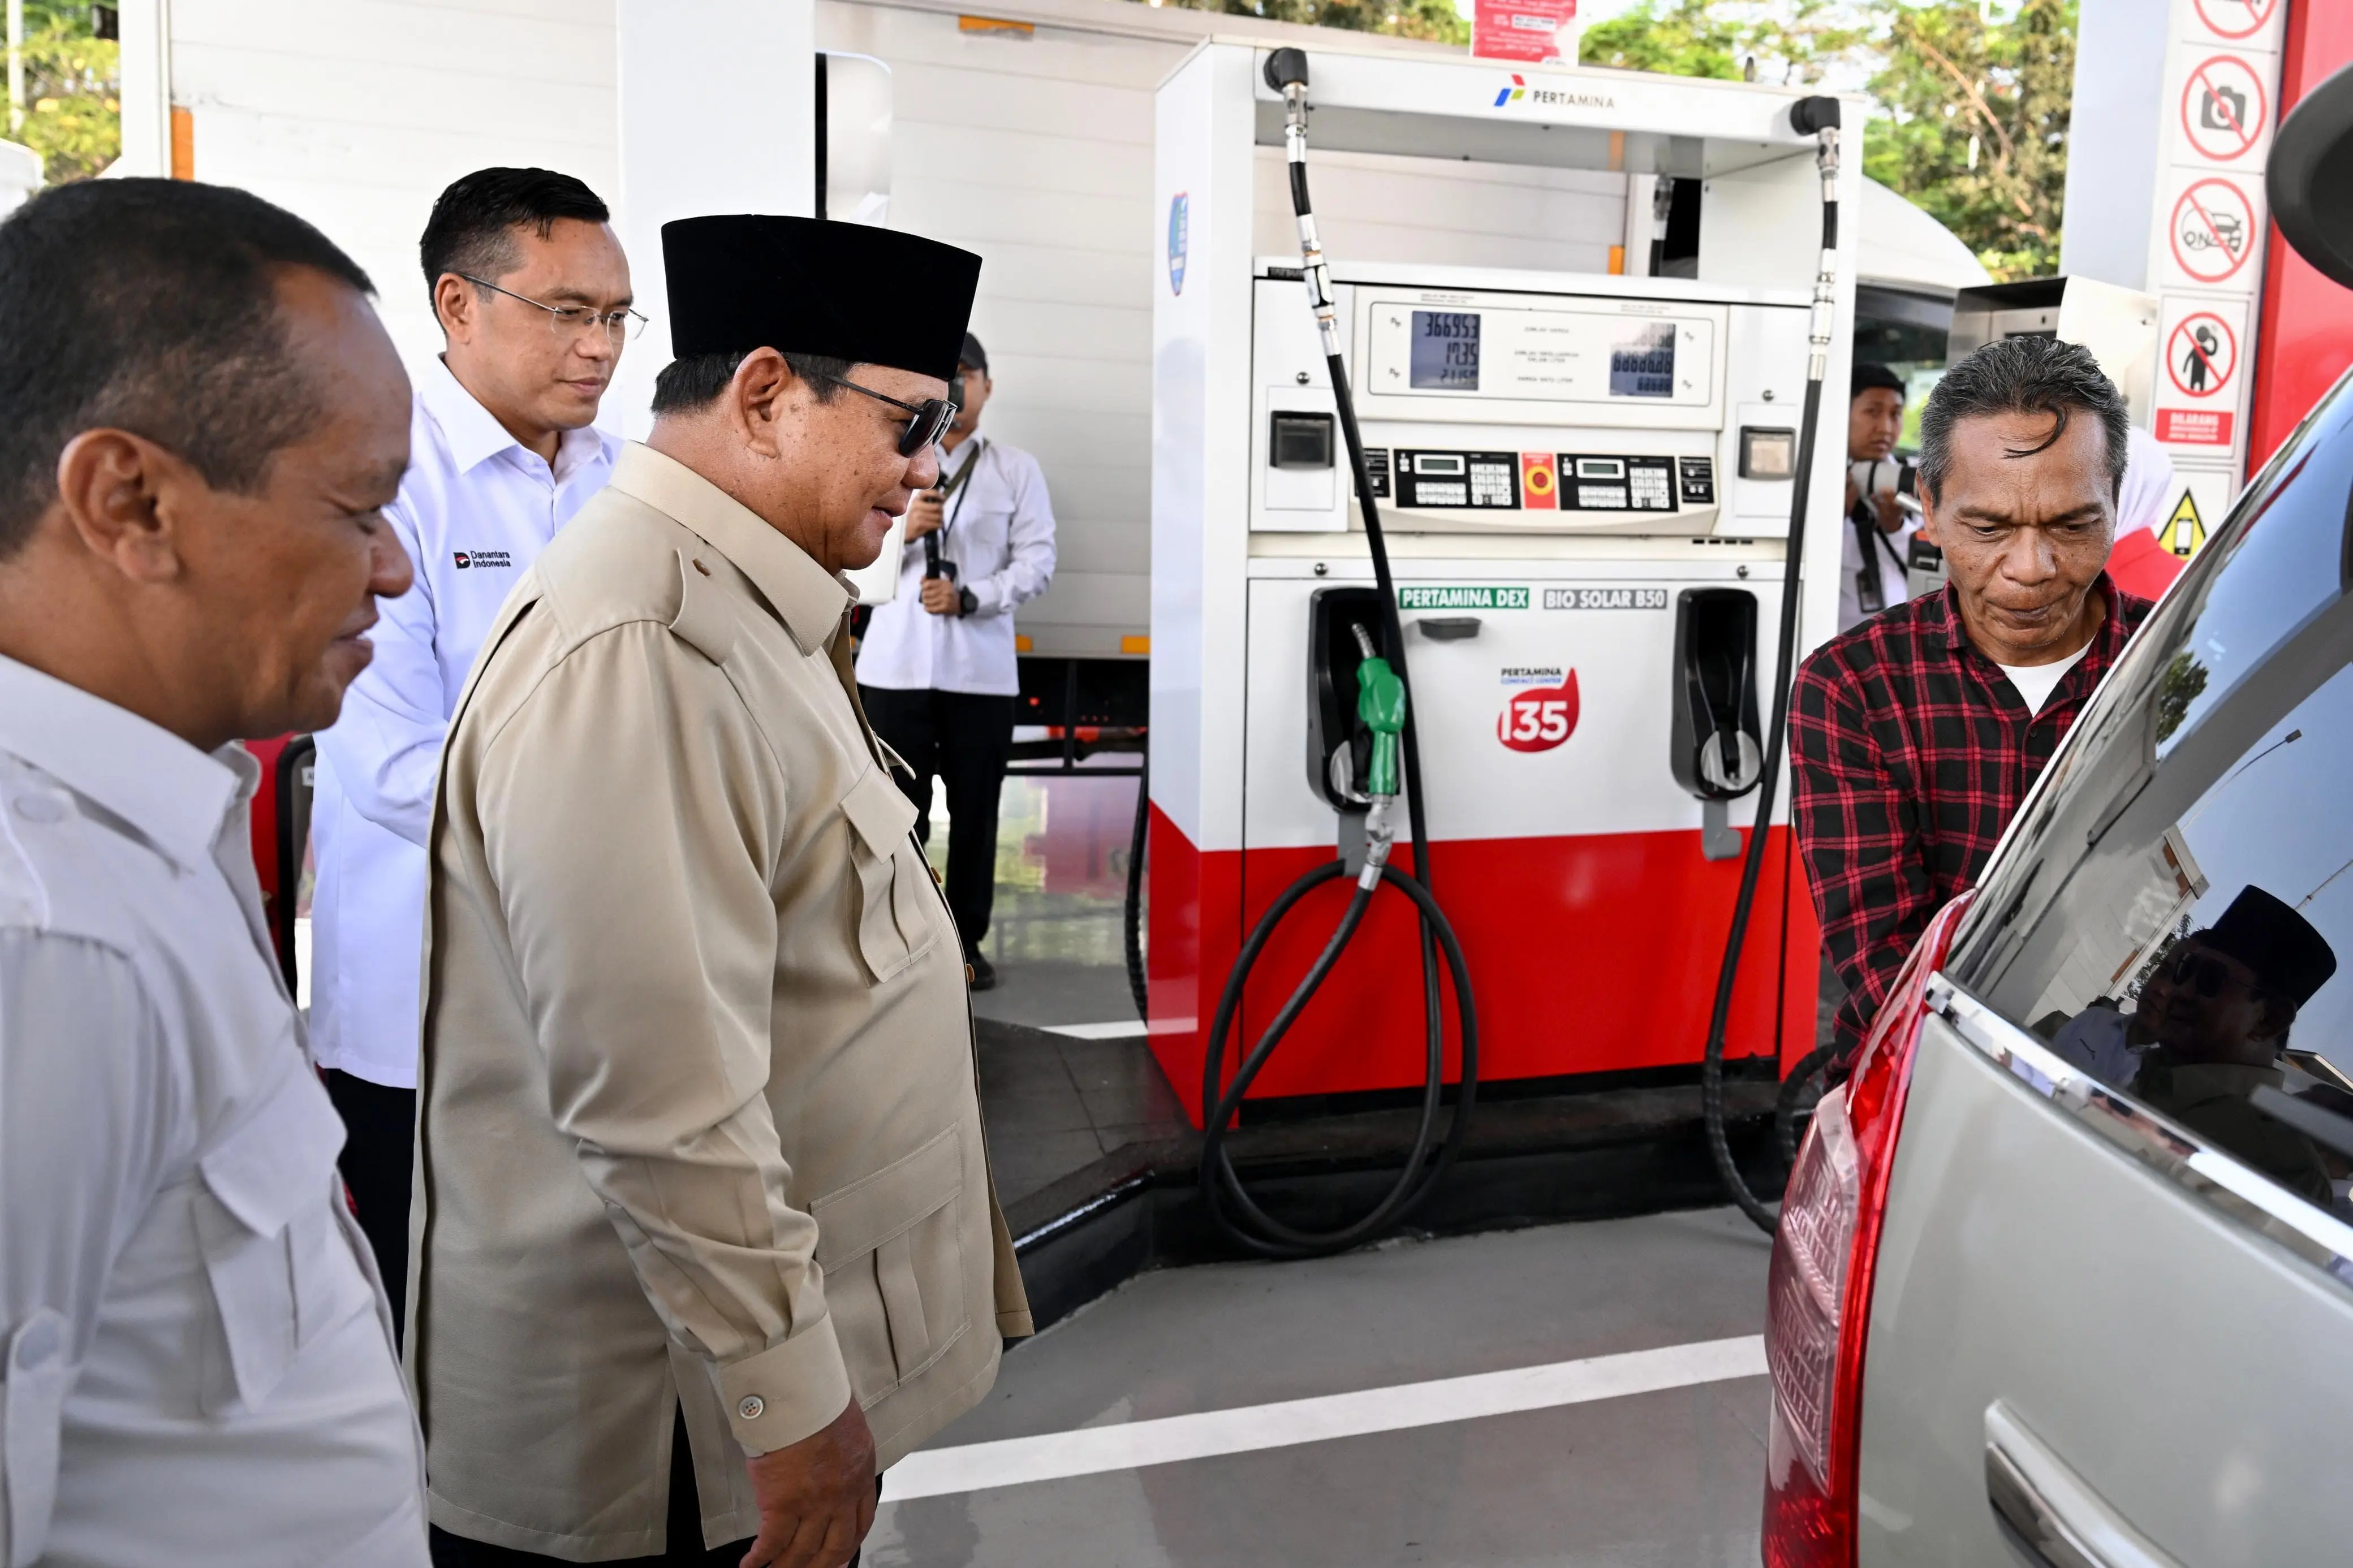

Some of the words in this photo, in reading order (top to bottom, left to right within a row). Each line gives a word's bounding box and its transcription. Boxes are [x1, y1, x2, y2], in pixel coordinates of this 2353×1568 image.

[1533, 90, 1614, 108] PERTAMINA
[470, 550, 510, 559] Danantara
[473, 559, 511, 568] Indonesia
[1402, 589, 1493, 607] PERTAMINA
[1496, 589, 1527, 607] DEX
[1545, 590, 1576, 608] BIO
[1579, 590, 1631, 608] SOLAR
[1635, 590, 1665, 608] B50
[1501, 668, 1562, 676] PERTAMINA
[1501, 701, 1568, 742] 135
